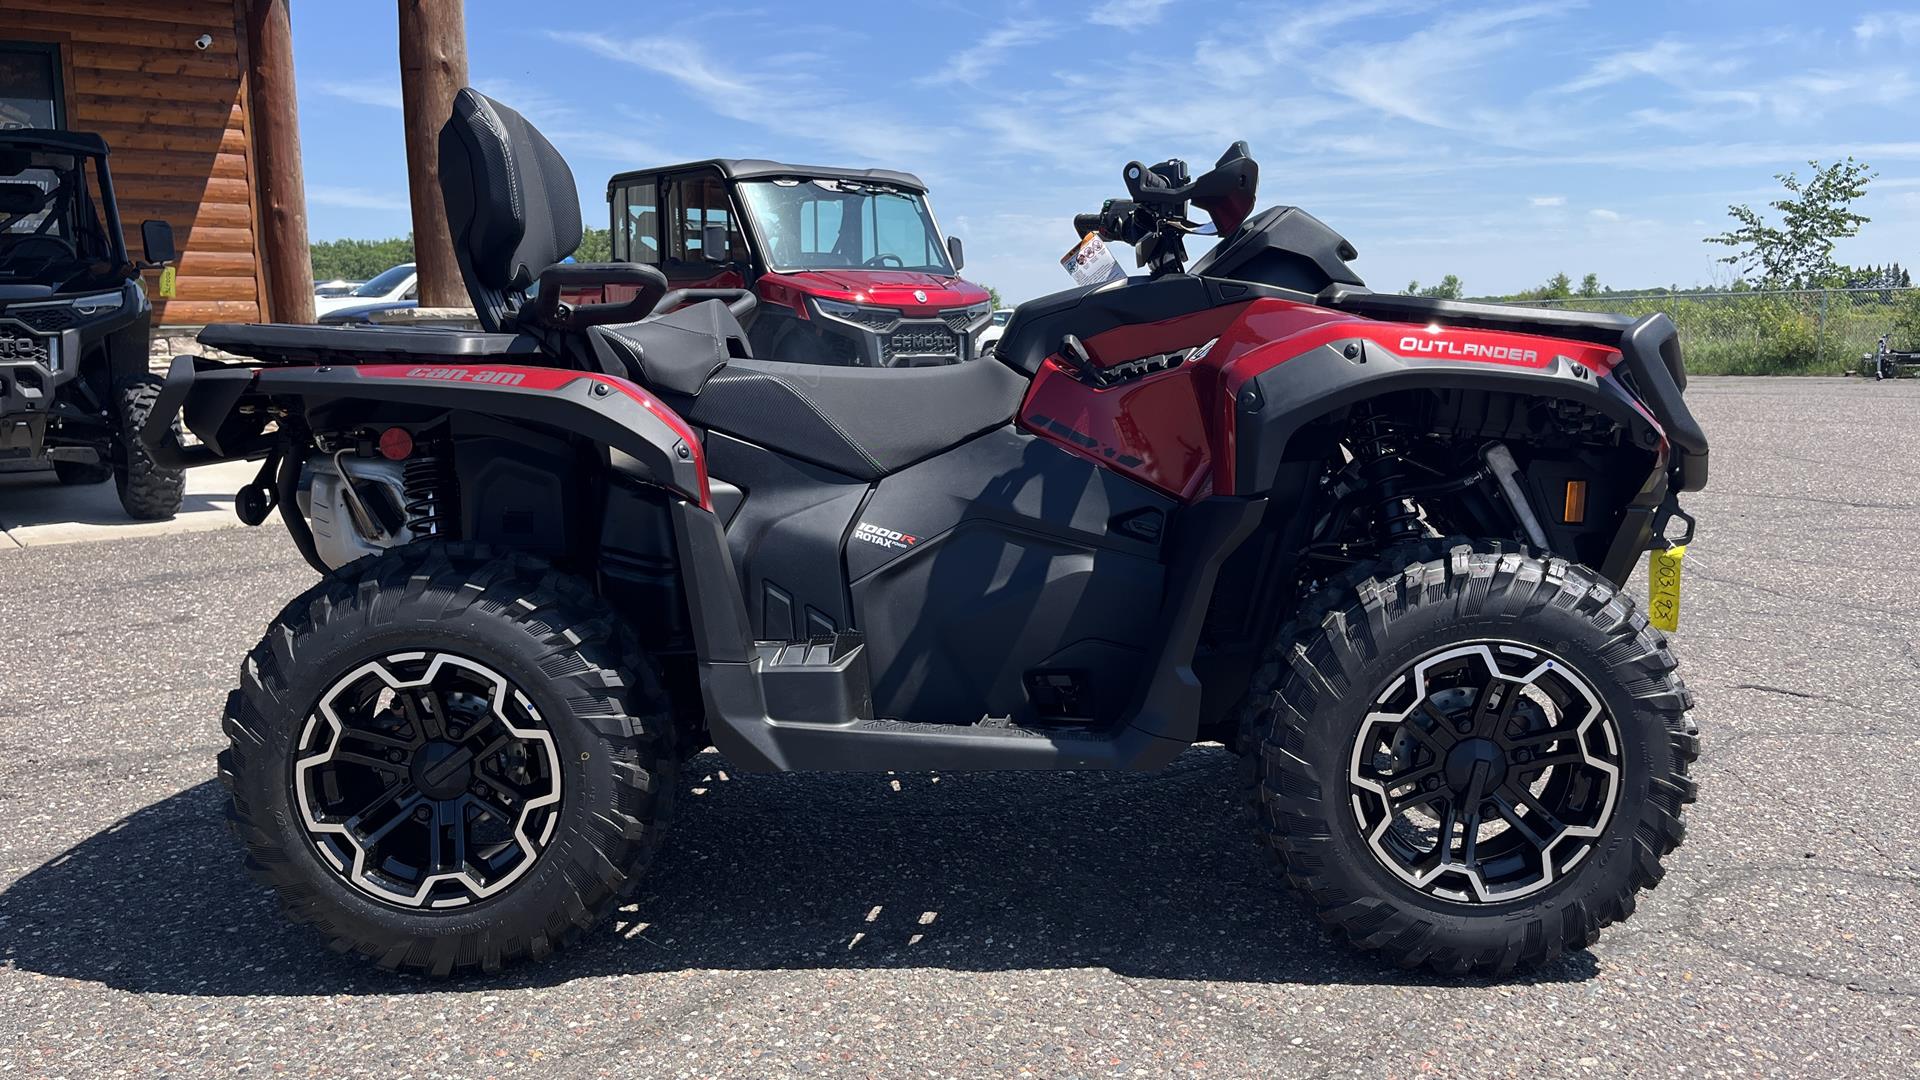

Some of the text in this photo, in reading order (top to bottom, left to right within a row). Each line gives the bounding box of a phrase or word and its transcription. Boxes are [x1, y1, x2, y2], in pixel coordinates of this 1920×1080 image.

[892, 336, 953, 347] CFMOTO
[1400, 337, 1537, 362] OUTLANDER
[406, 368, 526, 385] can-am
[855, 530, 892, 548] ROTAX
[857, 522, 917, 545] 1000R
